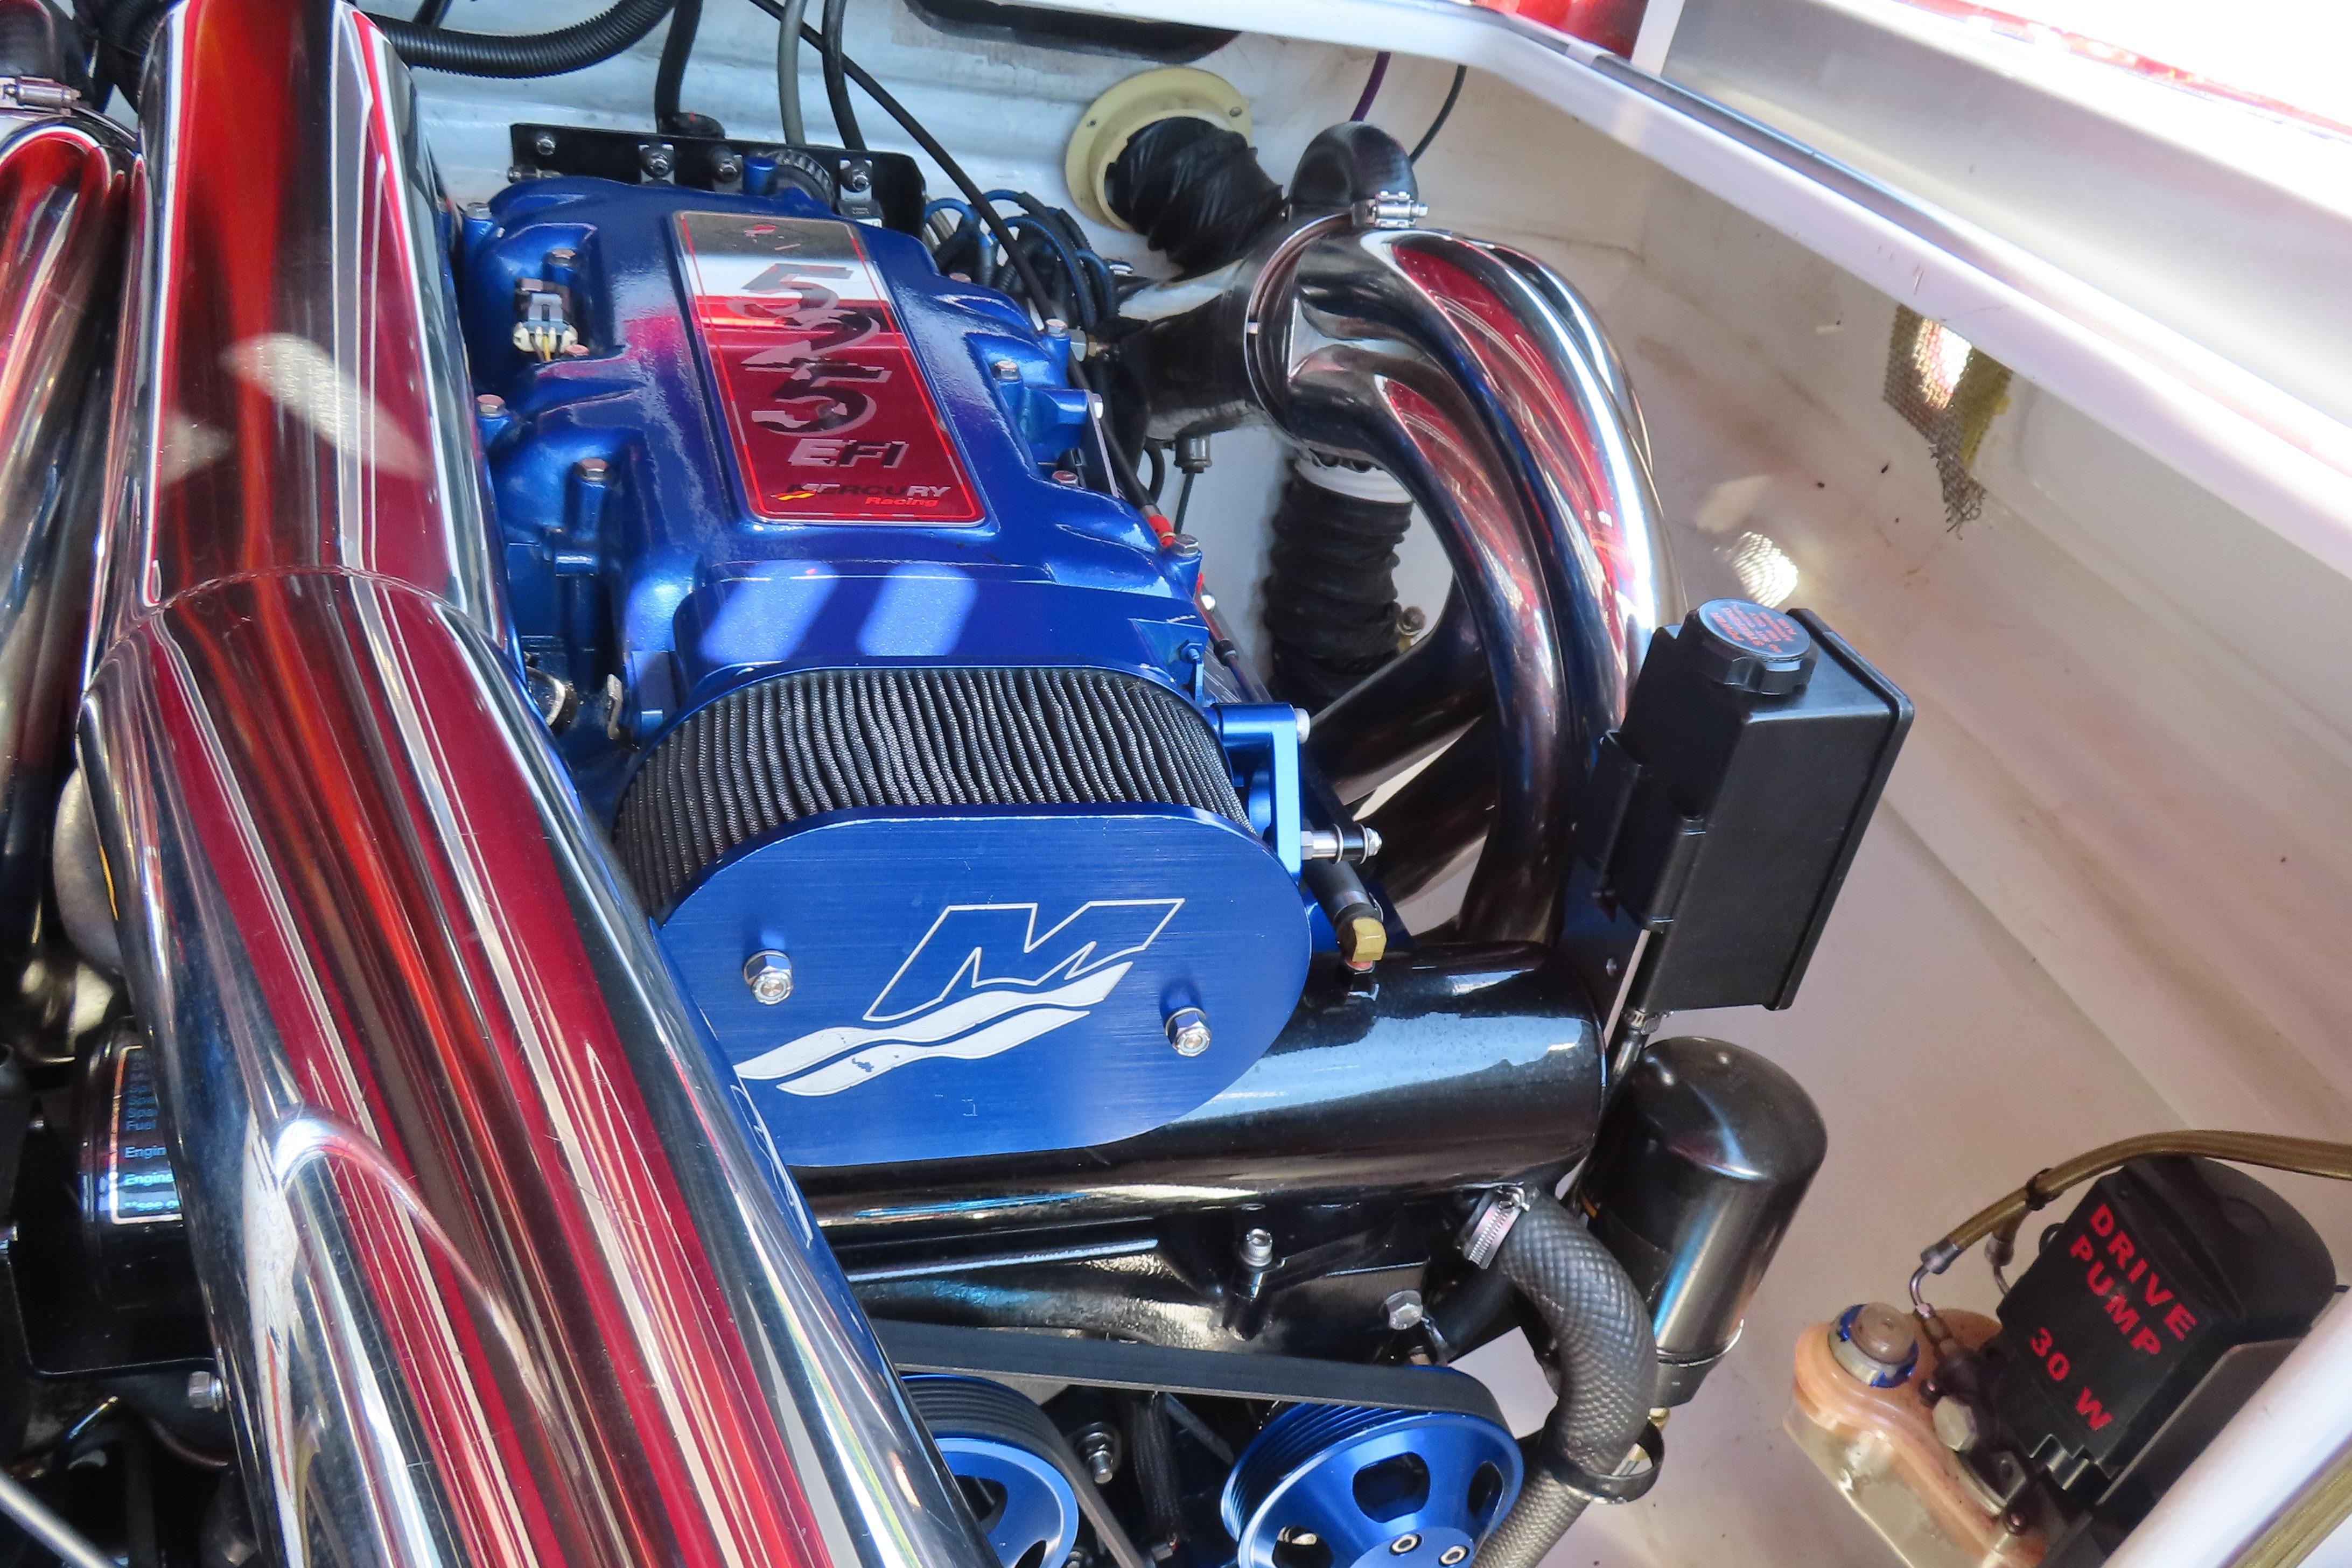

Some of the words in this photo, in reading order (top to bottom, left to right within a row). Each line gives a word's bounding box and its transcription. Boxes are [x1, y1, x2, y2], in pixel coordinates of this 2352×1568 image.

[788, 438, 909, 468] EFI
[865, 496, 939, 507] Racing
[125, 1145, 167, 1158] Engin
[2069, 1234, 2161, 1354] PUMP
[2090, 1203, 2198, 1341] DRIVE
[2030, 1327, 2070, 1381] 30
[2075, 1386, 2114, 1431] W
